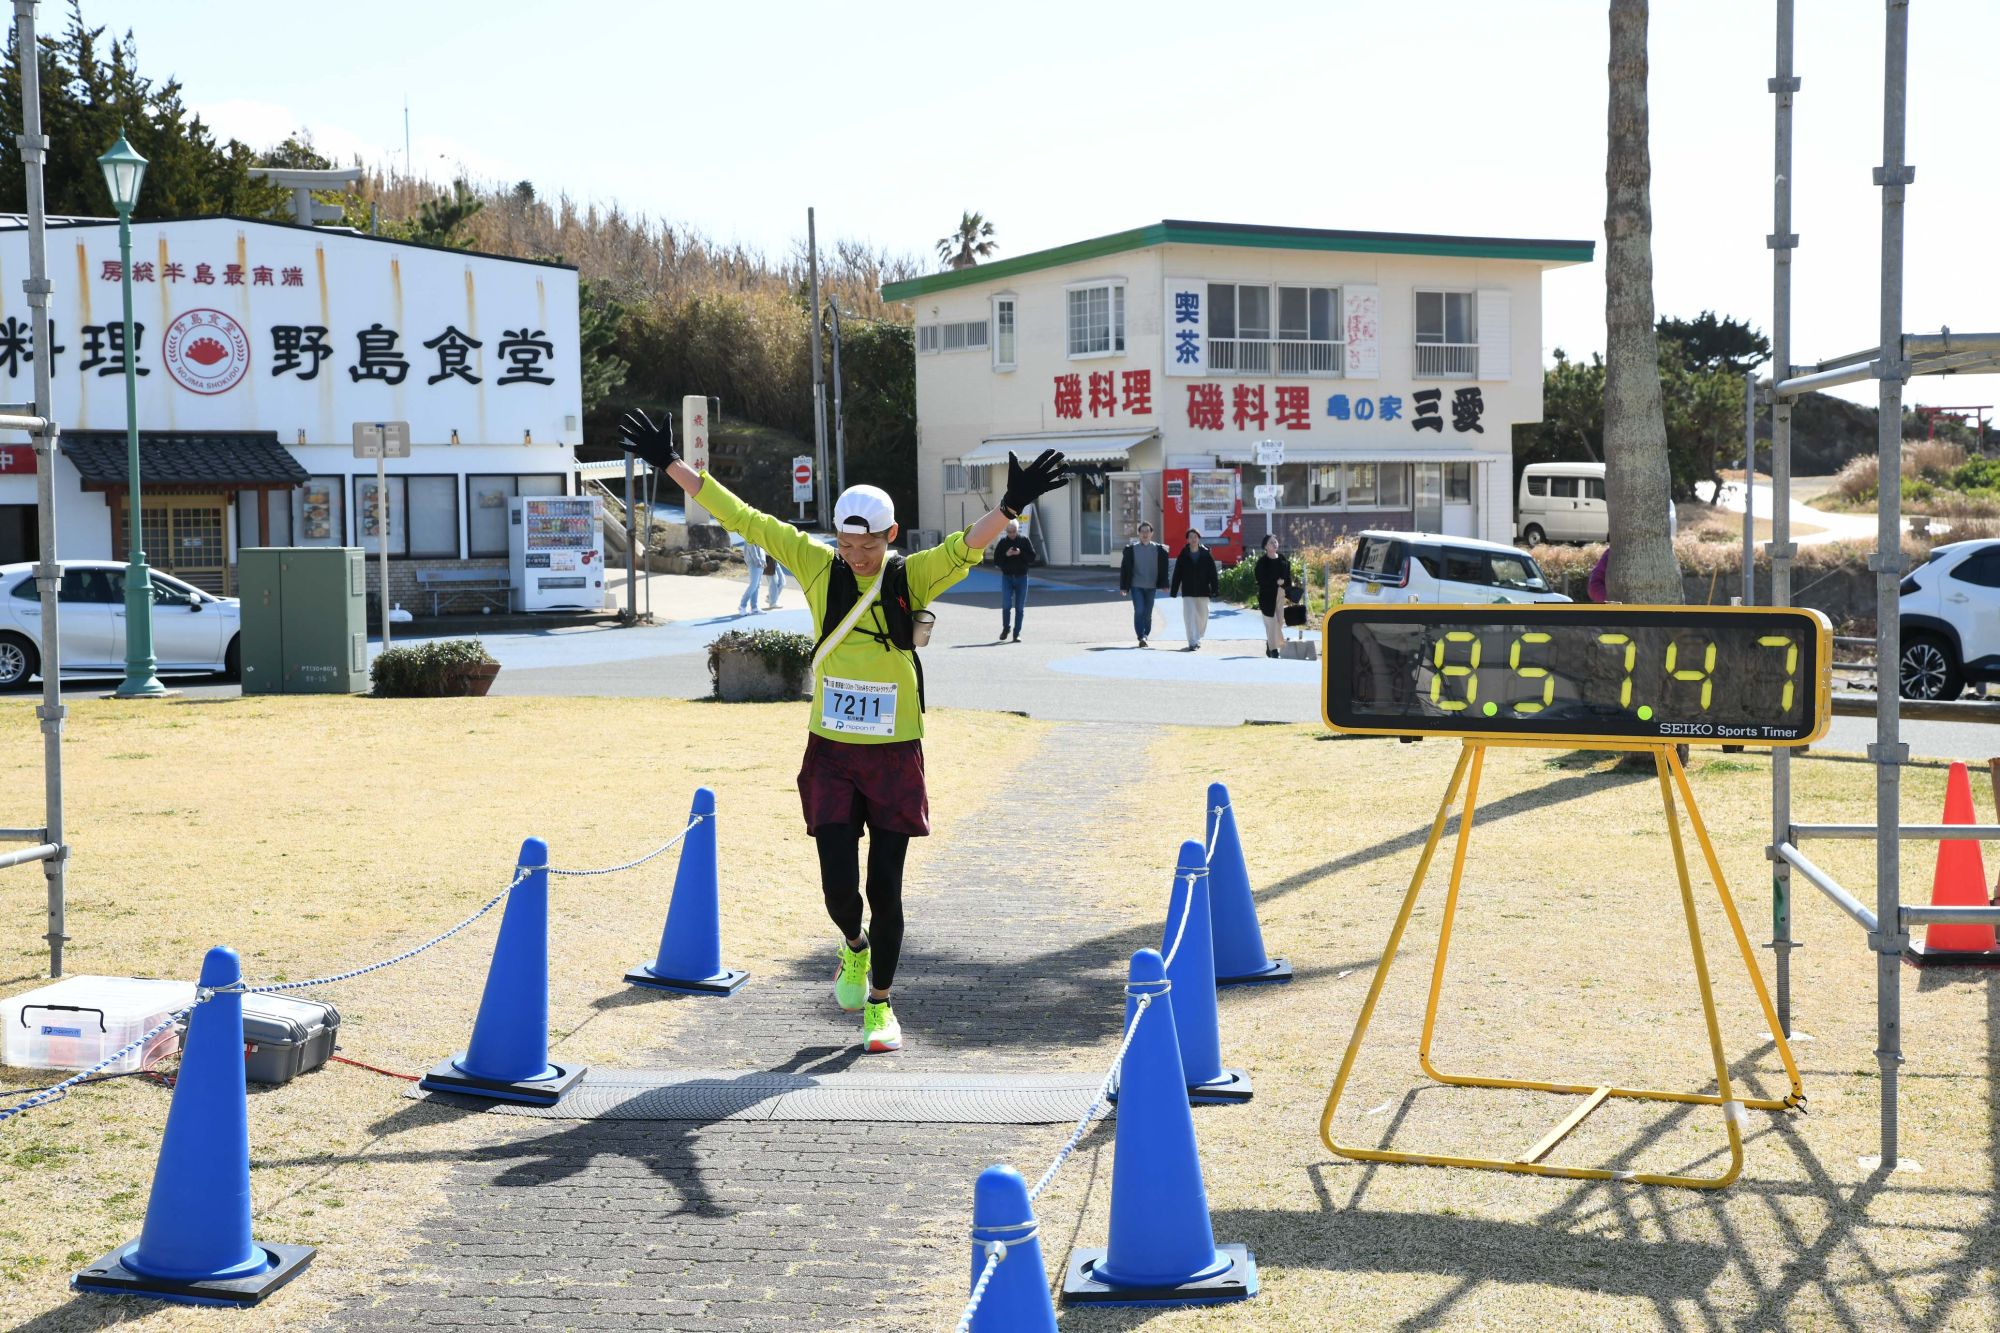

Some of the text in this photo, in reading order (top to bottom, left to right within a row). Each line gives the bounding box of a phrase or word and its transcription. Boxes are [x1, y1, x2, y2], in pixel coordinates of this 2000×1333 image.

[101, 260, 304, 287] 房総半島最南端
[173, 313, 237, 335] 野島食堂
[1175, 290, 1200, 364] 喫茶
[270, 323, 556, 386] 野島食堂
[176, 365, 240, 389] NOJIMA SHOKUDO
[1054, 369, 1152, 420] 磯料理
[1186, 383, 1311, 431] 磯料理
[1327, 394, 1402, 421] 亀の家
[833, 692, 880, 718] 7211
[1660, 722, 1798, 738] SEIKO Sports Timer
